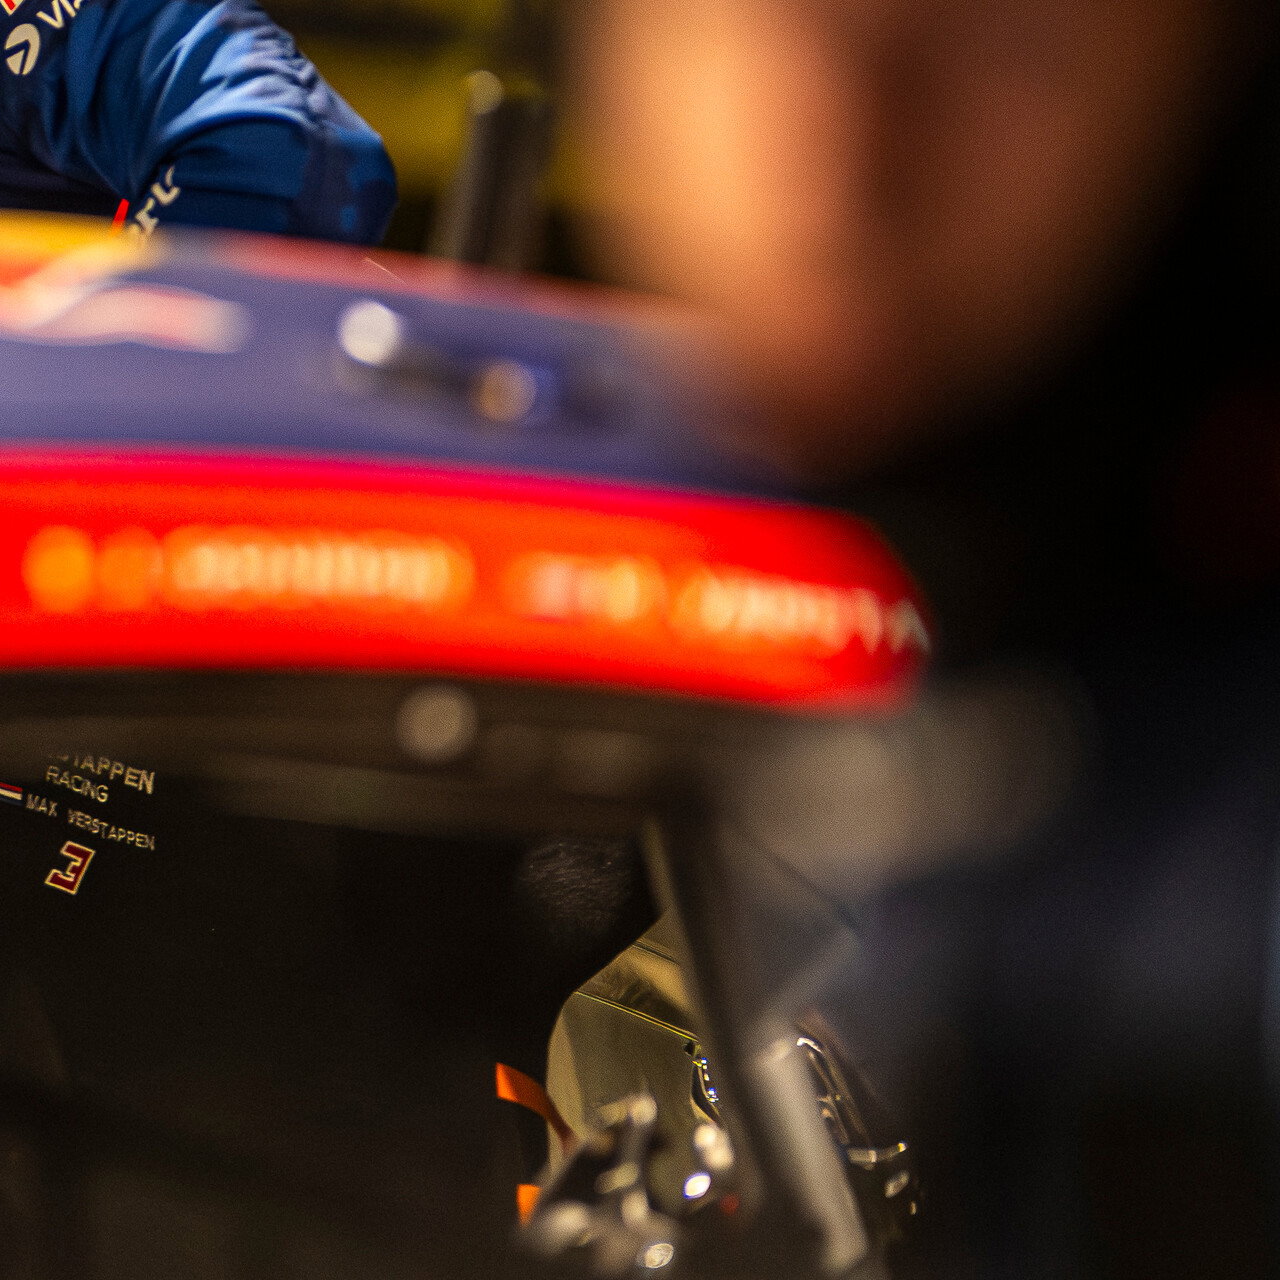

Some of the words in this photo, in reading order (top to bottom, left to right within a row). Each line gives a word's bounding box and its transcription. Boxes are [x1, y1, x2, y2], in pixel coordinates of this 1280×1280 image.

[46, 764, 109, 803] RACING
[56, 753, 156, 796] TAPPEN
[25, 792, 59, 818] MAX
[66, 807, 156, 852] VERSTAPPEN
[43, 839, 97, 896] 3
